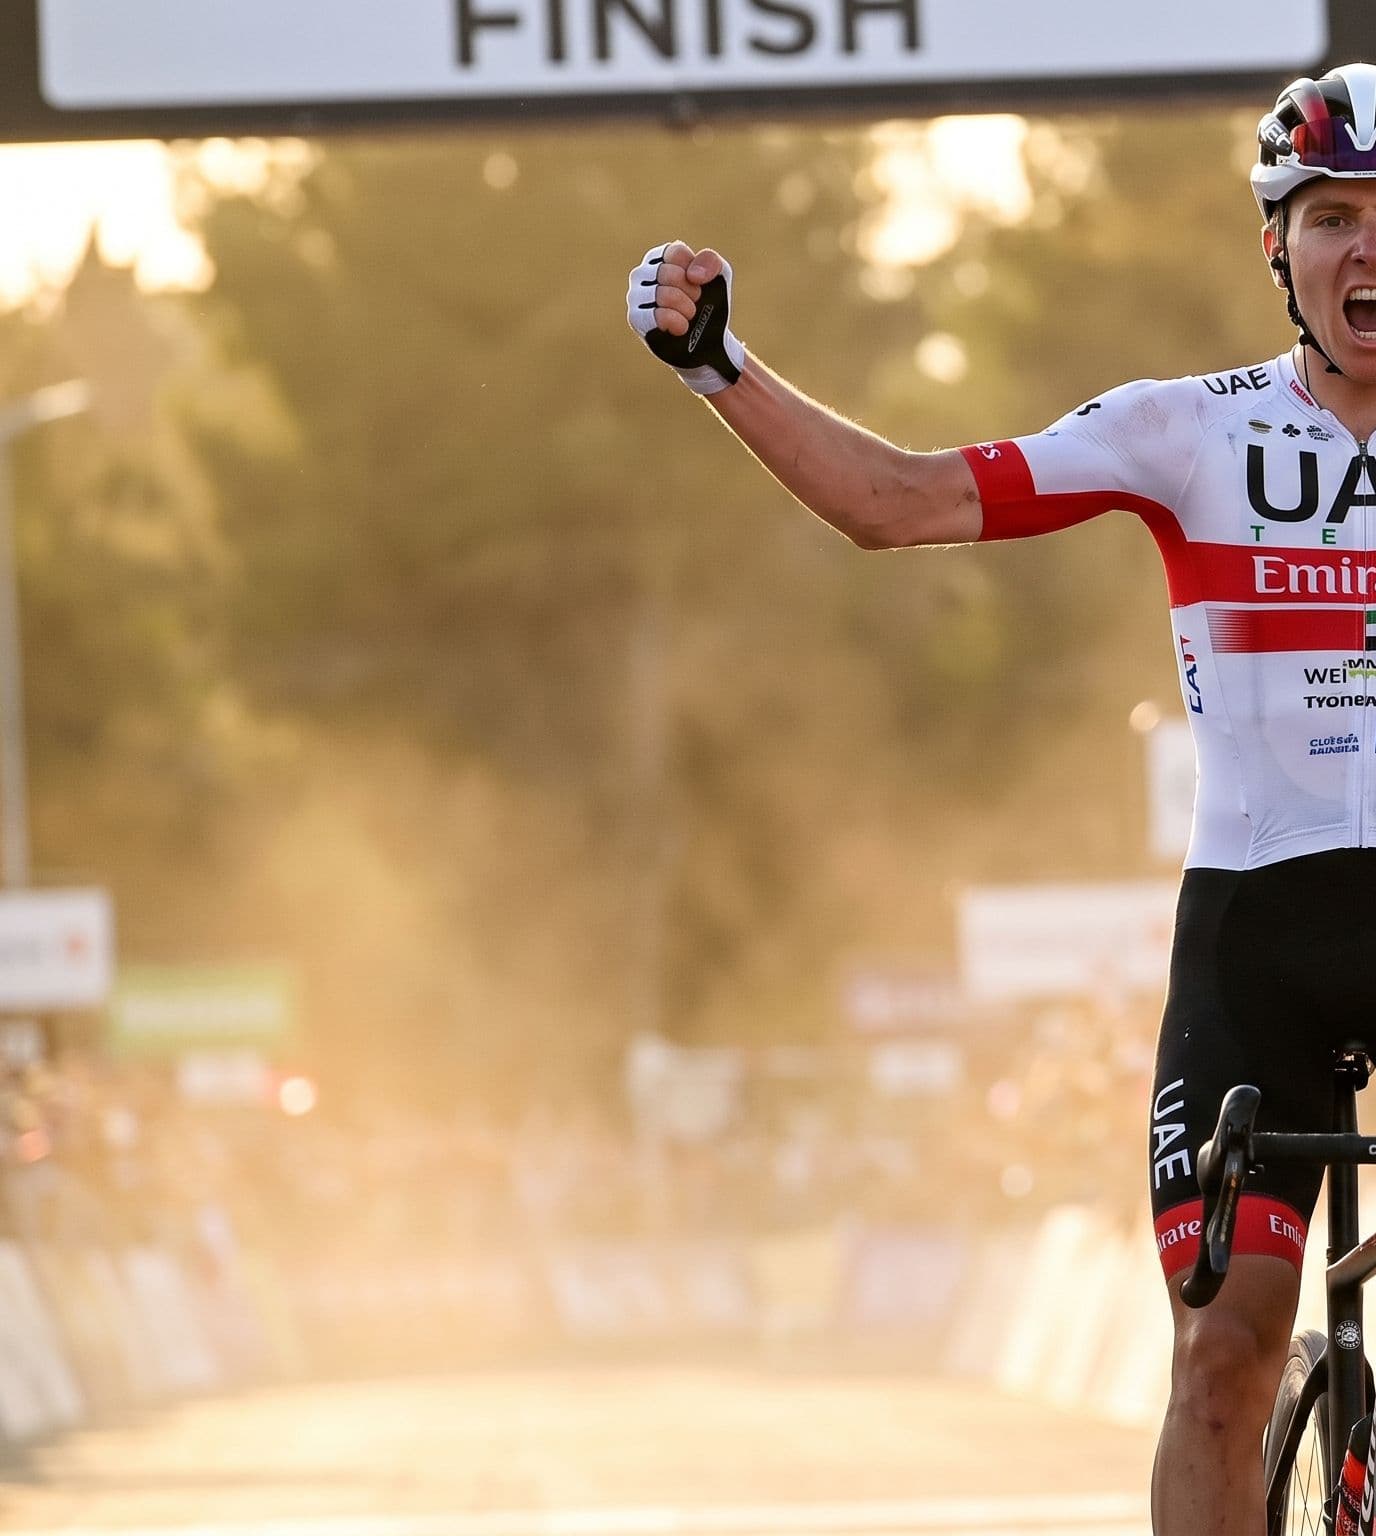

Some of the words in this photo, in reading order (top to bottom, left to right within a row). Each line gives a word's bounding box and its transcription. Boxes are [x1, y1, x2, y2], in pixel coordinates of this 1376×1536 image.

[453, 0, 922, 70] FINISH
[1203, 366, 1271, 396] UAE
[1153, 1078, 1191, 1190] UAE
